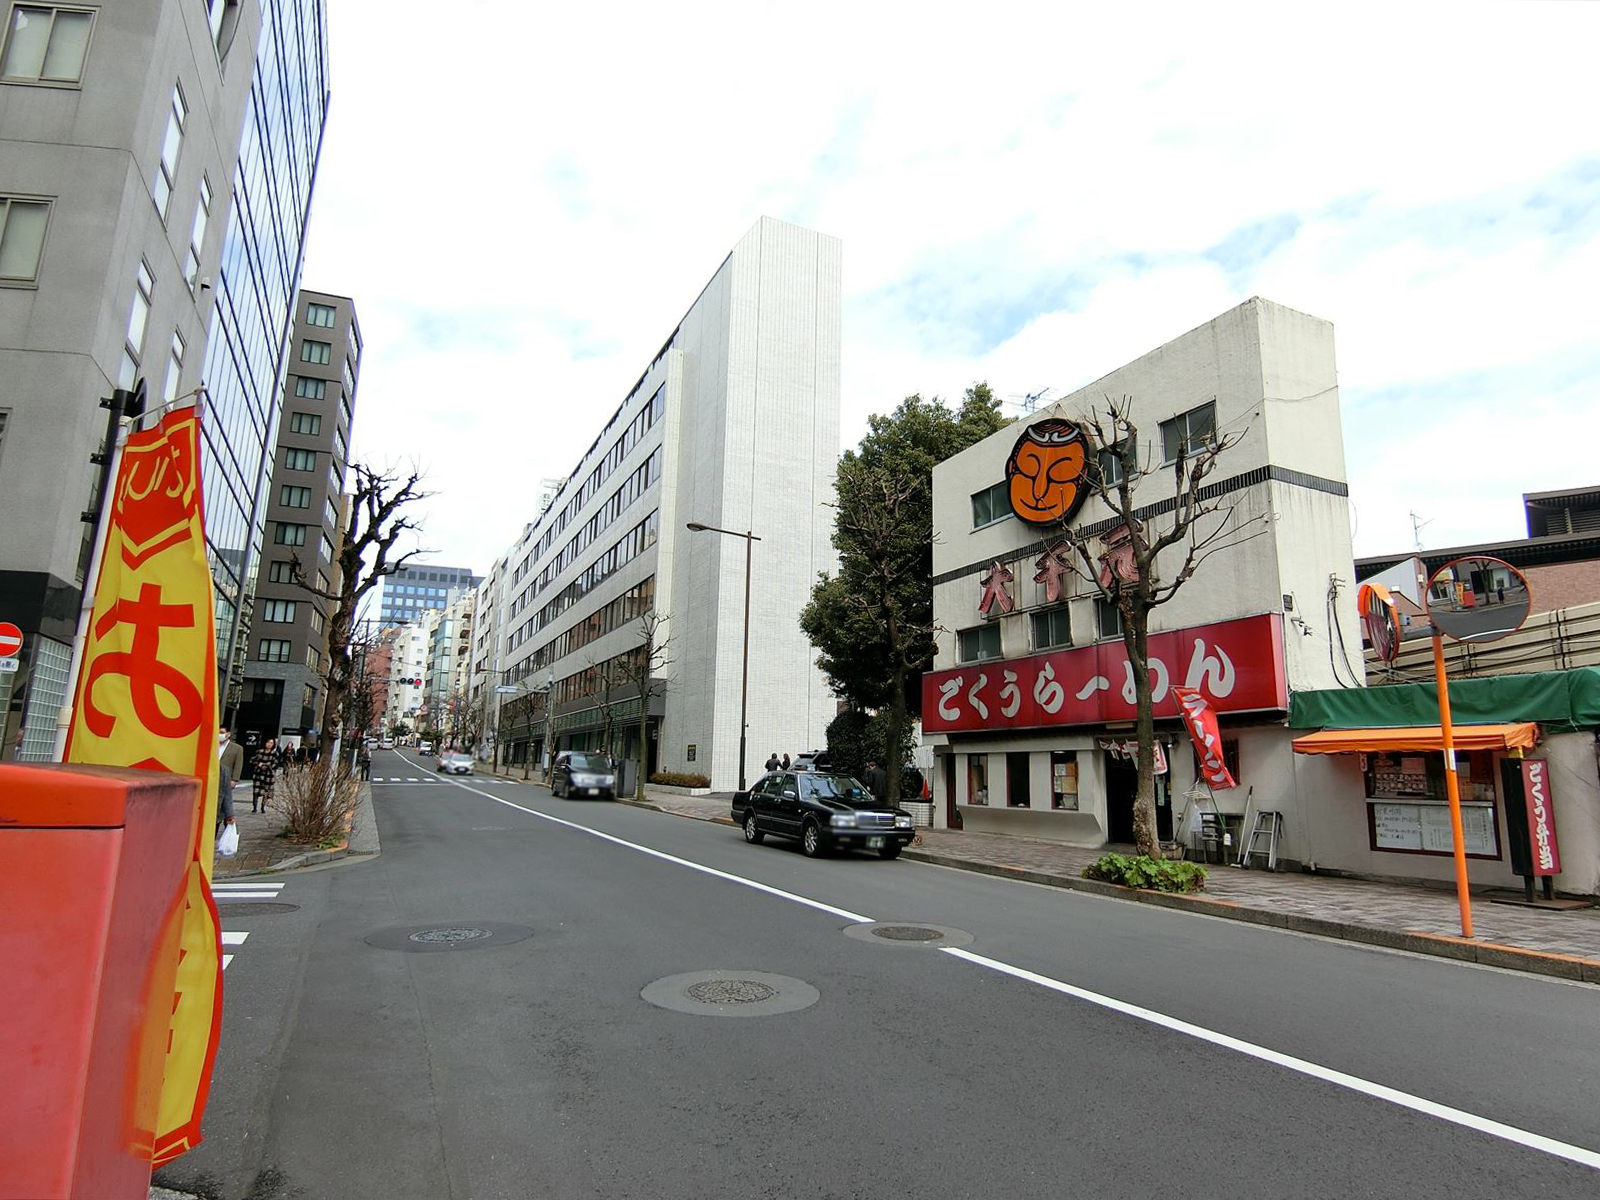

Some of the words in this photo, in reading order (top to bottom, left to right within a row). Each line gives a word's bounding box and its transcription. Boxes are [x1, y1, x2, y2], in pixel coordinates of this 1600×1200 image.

[938, 638, 1235, 722] ごくうらーめん
